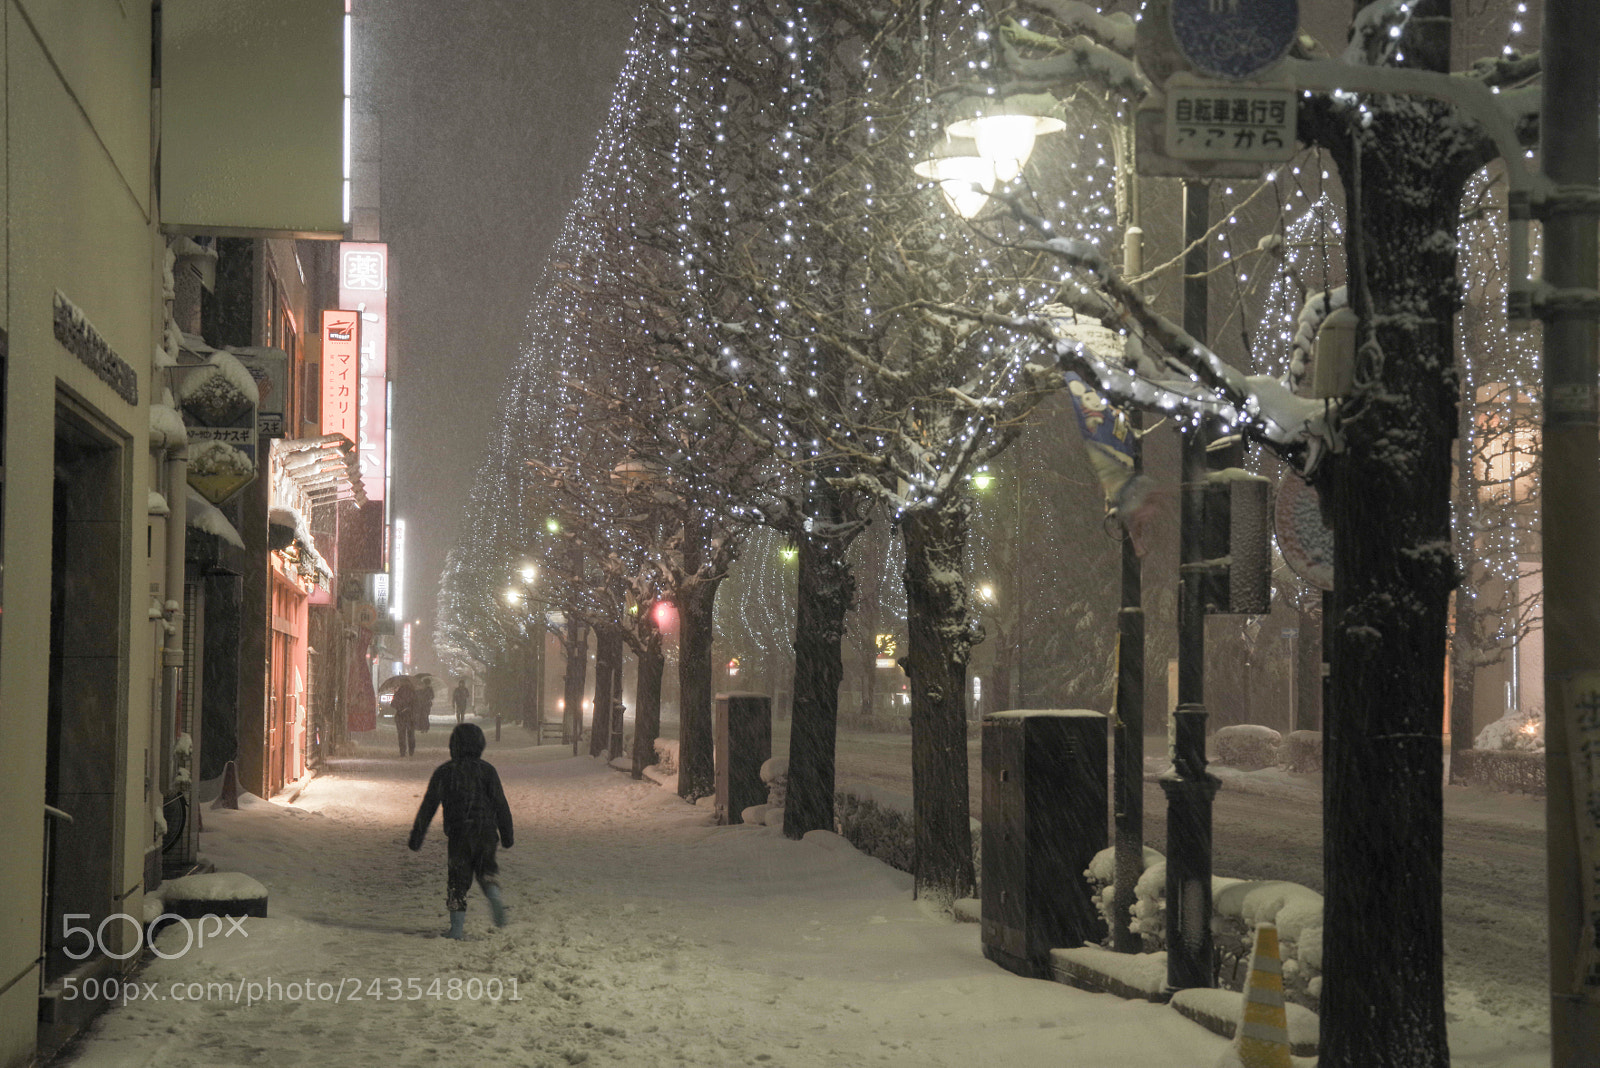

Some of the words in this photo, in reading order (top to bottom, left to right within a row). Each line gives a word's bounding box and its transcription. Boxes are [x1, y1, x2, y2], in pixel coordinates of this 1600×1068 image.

[1176, 98, 1286, 124] 自転車通行可
[347, 254, 379, 287] 薬
[213, 429, 250, 442] カナスギ
